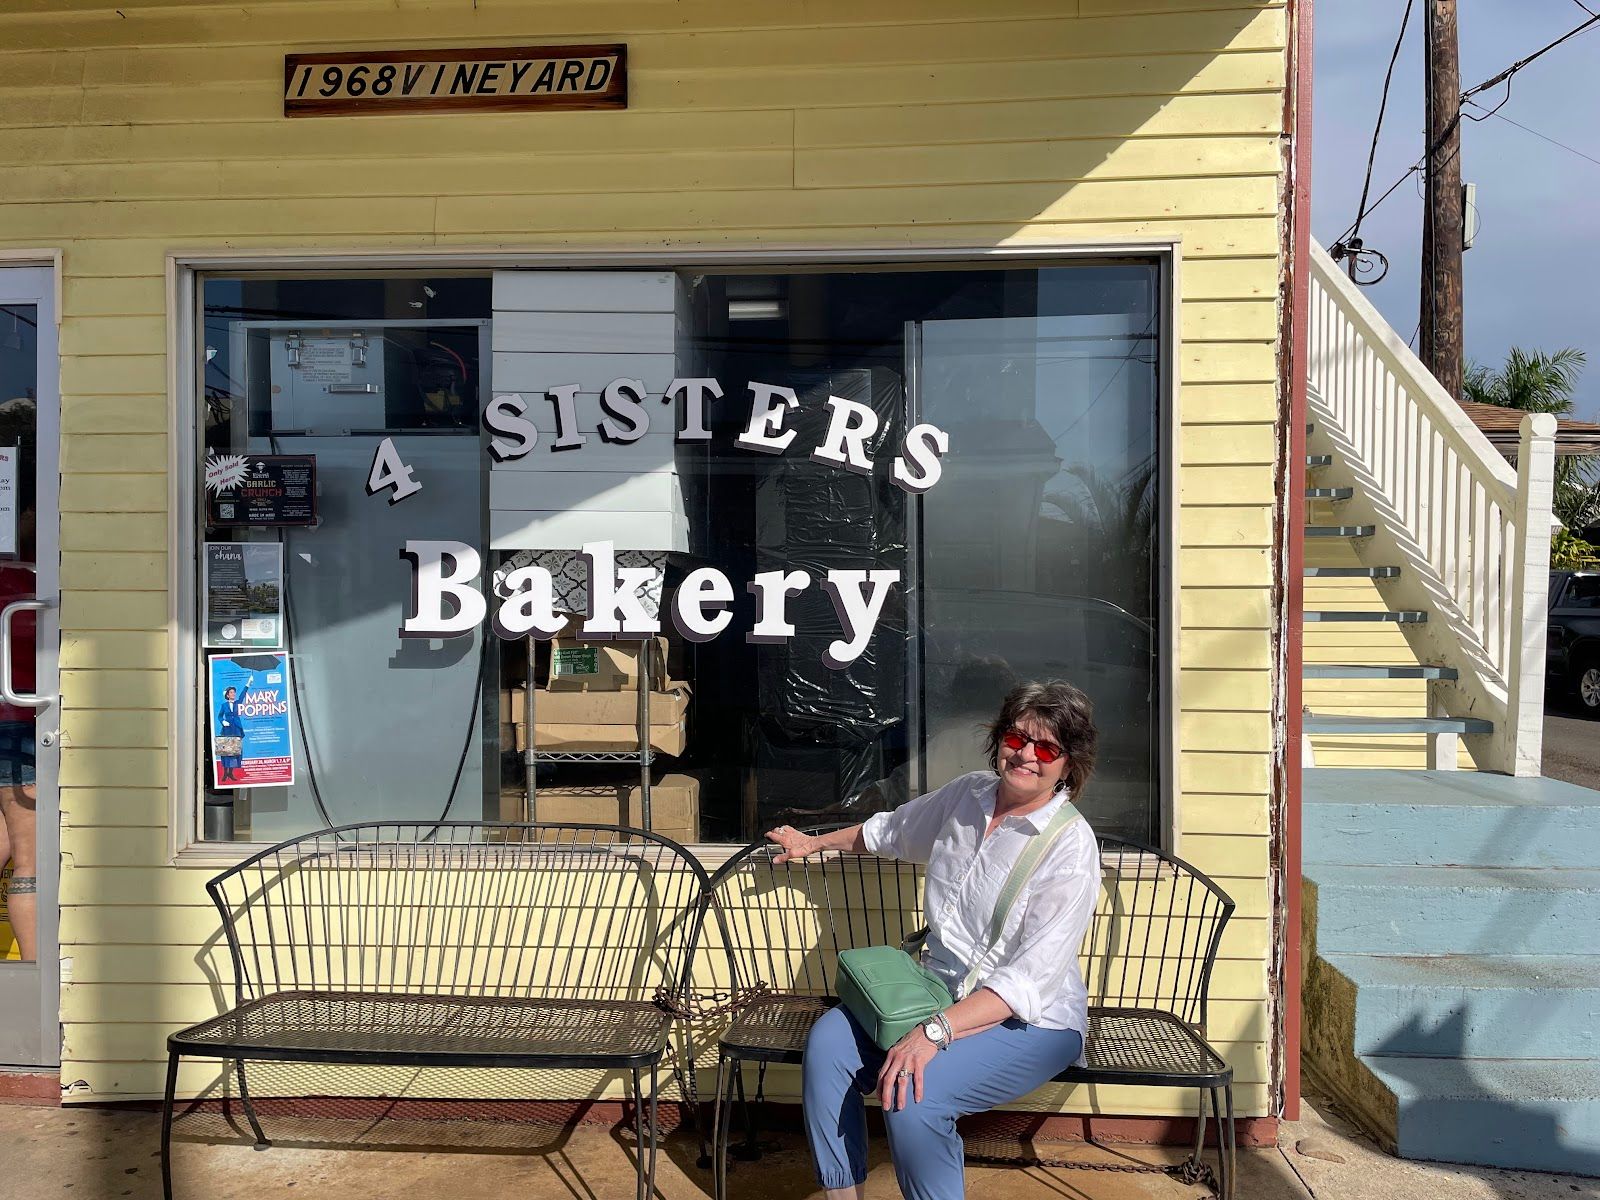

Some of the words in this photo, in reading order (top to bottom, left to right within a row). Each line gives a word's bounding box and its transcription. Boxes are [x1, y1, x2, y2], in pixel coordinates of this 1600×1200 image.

[366, 436, 423, 504] 4
[482, 376, 950, 495] SISTERS
[208, 467, 224, 478] Only
[224, 460, 239, 472] Sold
[219, 475, 236, 485] Here
[246, 480, 277, 488] GARLIC
[240, 488, 283, 497] CRUNCH
[399, 540, 900, 669] Bakery
[246, 690, 279, 704] MARY
[238, 701, 287, 716] POPPINS
